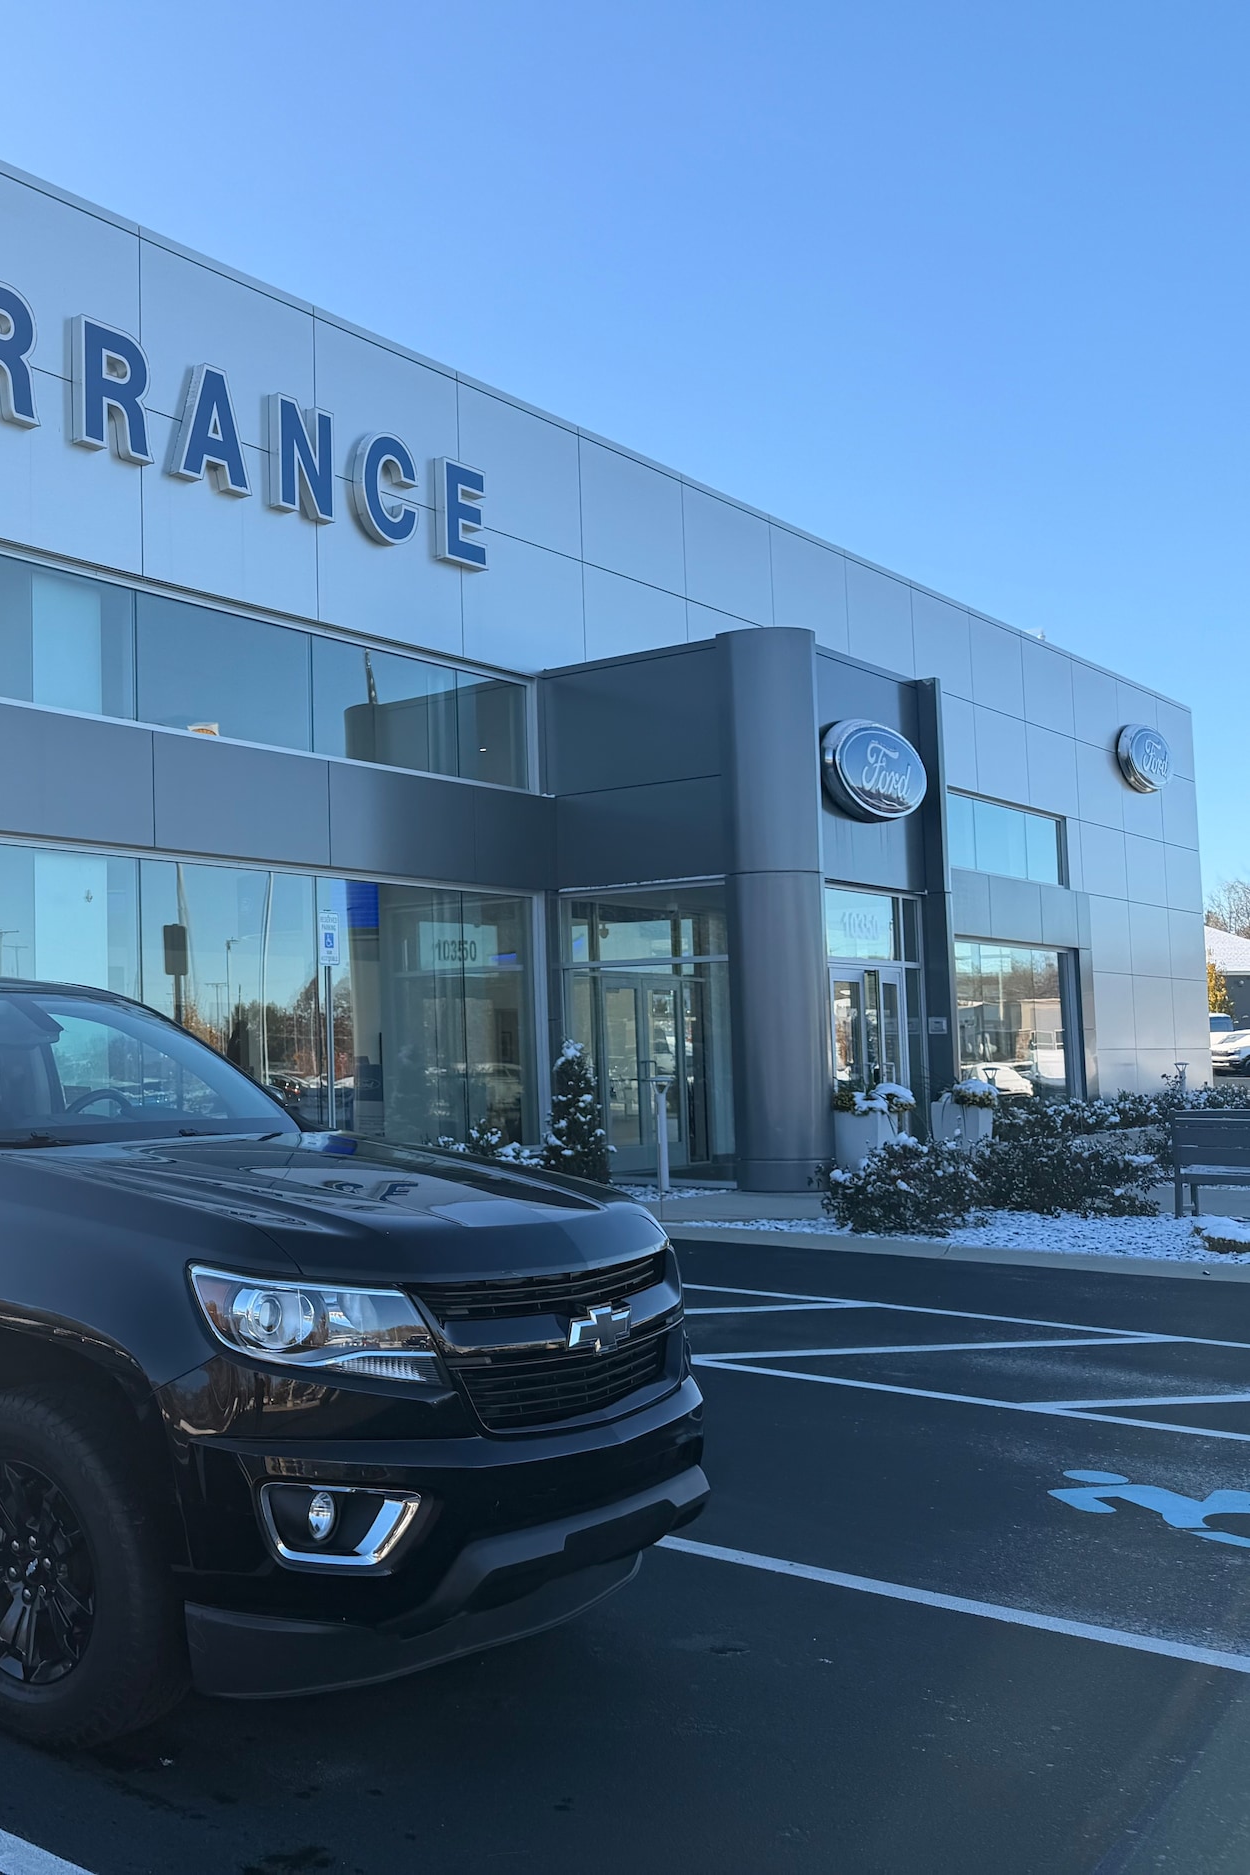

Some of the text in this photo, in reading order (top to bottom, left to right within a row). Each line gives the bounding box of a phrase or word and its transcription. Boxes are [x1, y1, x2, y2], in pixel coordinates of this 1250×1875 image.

[862, 740, 911, 800] Ford
[1141, 739, 1169, 779] Ford
[435, 939, 477, 962] 10350
